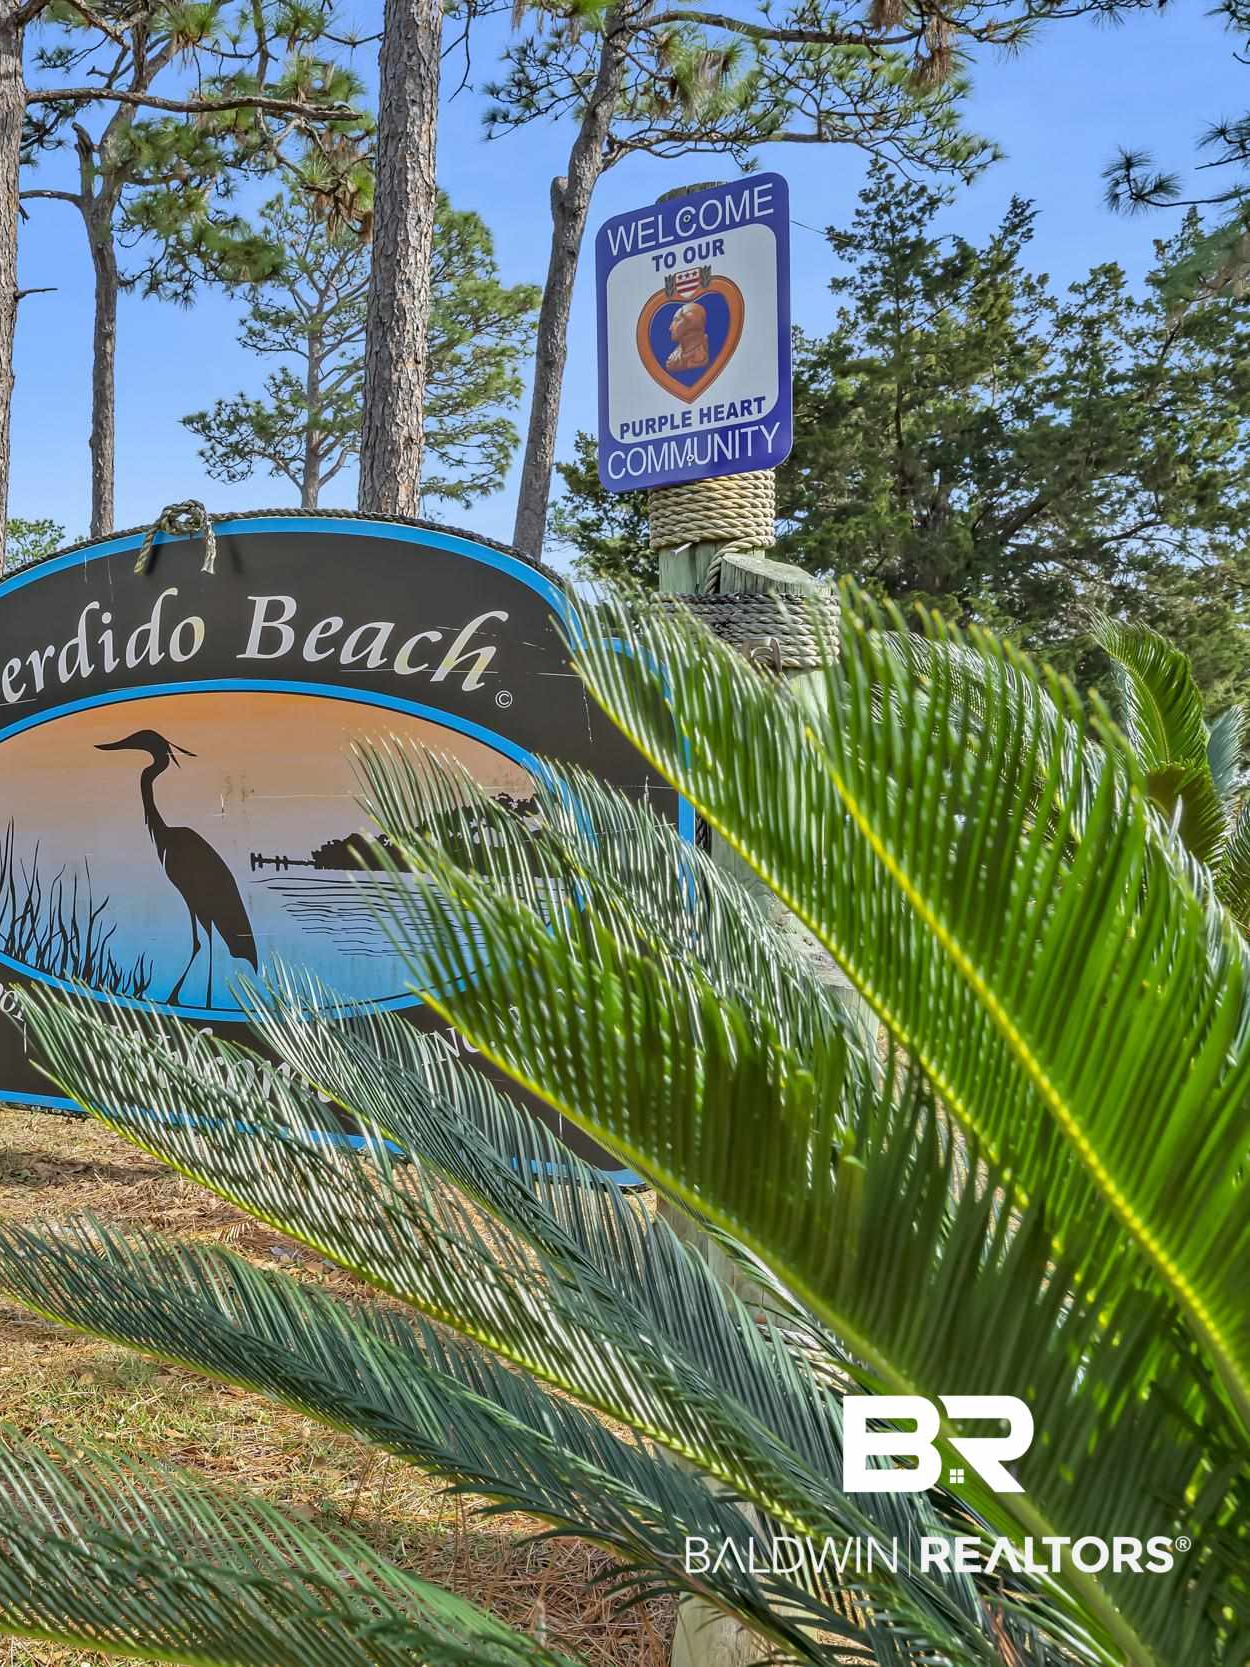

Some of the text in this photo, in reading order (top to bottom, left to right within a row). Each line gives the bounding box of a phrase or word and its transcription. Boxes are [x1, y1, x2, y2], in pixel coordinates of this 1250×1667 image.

[607, 183, 775, 257] WELCOME
[652, 238, 725, 272] TO OUR
[619, 396, 767, 440] PURPLE HEART
[607, 421, 781, 480] COMMUNITY
[236, 595, 509, 692] Beach
